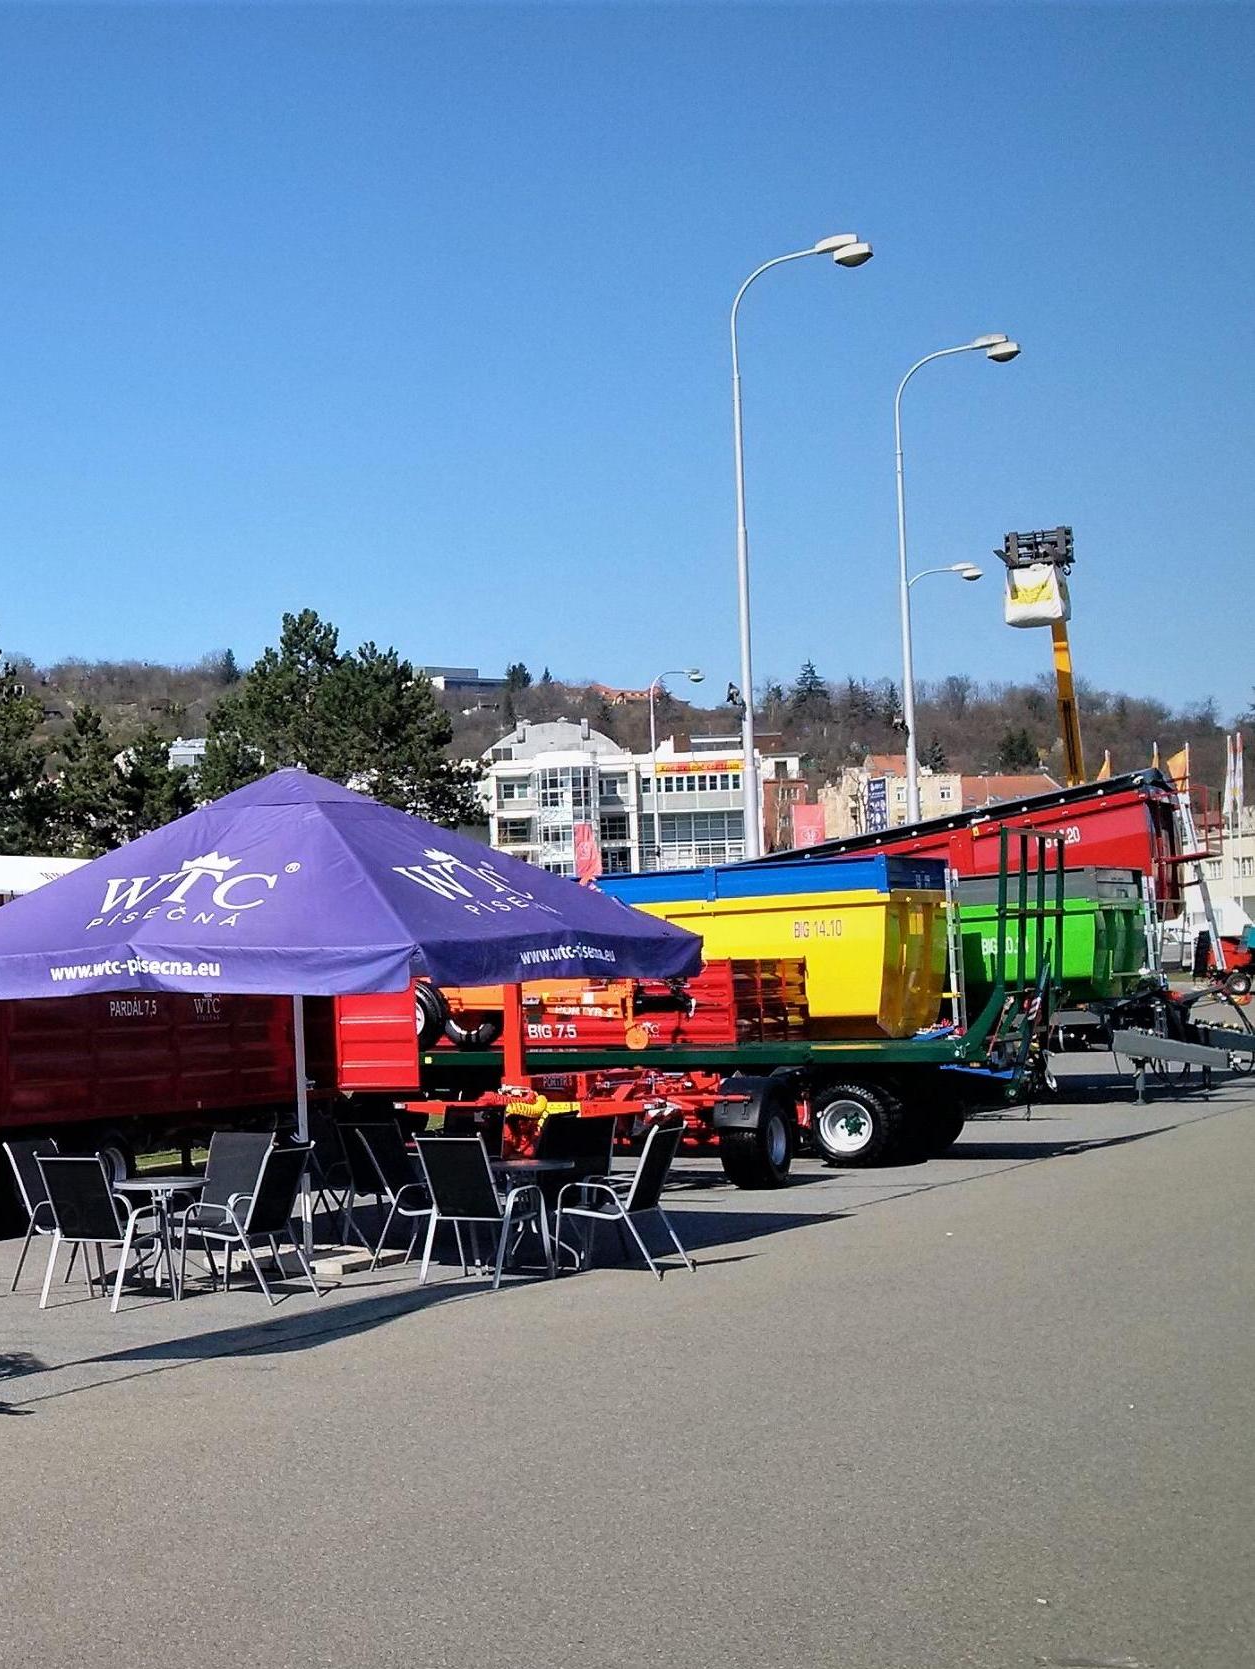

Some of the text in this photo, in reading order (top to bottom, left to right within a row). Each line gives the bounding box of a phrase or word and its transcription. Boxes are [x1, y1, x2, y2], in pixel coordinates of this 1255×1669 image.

[794, 919, 842, 938] BIG 14.10
[50, 956, 221, 981] www.wtc-pisecna.eu
[109, 996, 144, 1016] PARDÁL
[193, 998, 221, 1014] WTC
[527, 1024, 577, 1039] BIG 7.5
